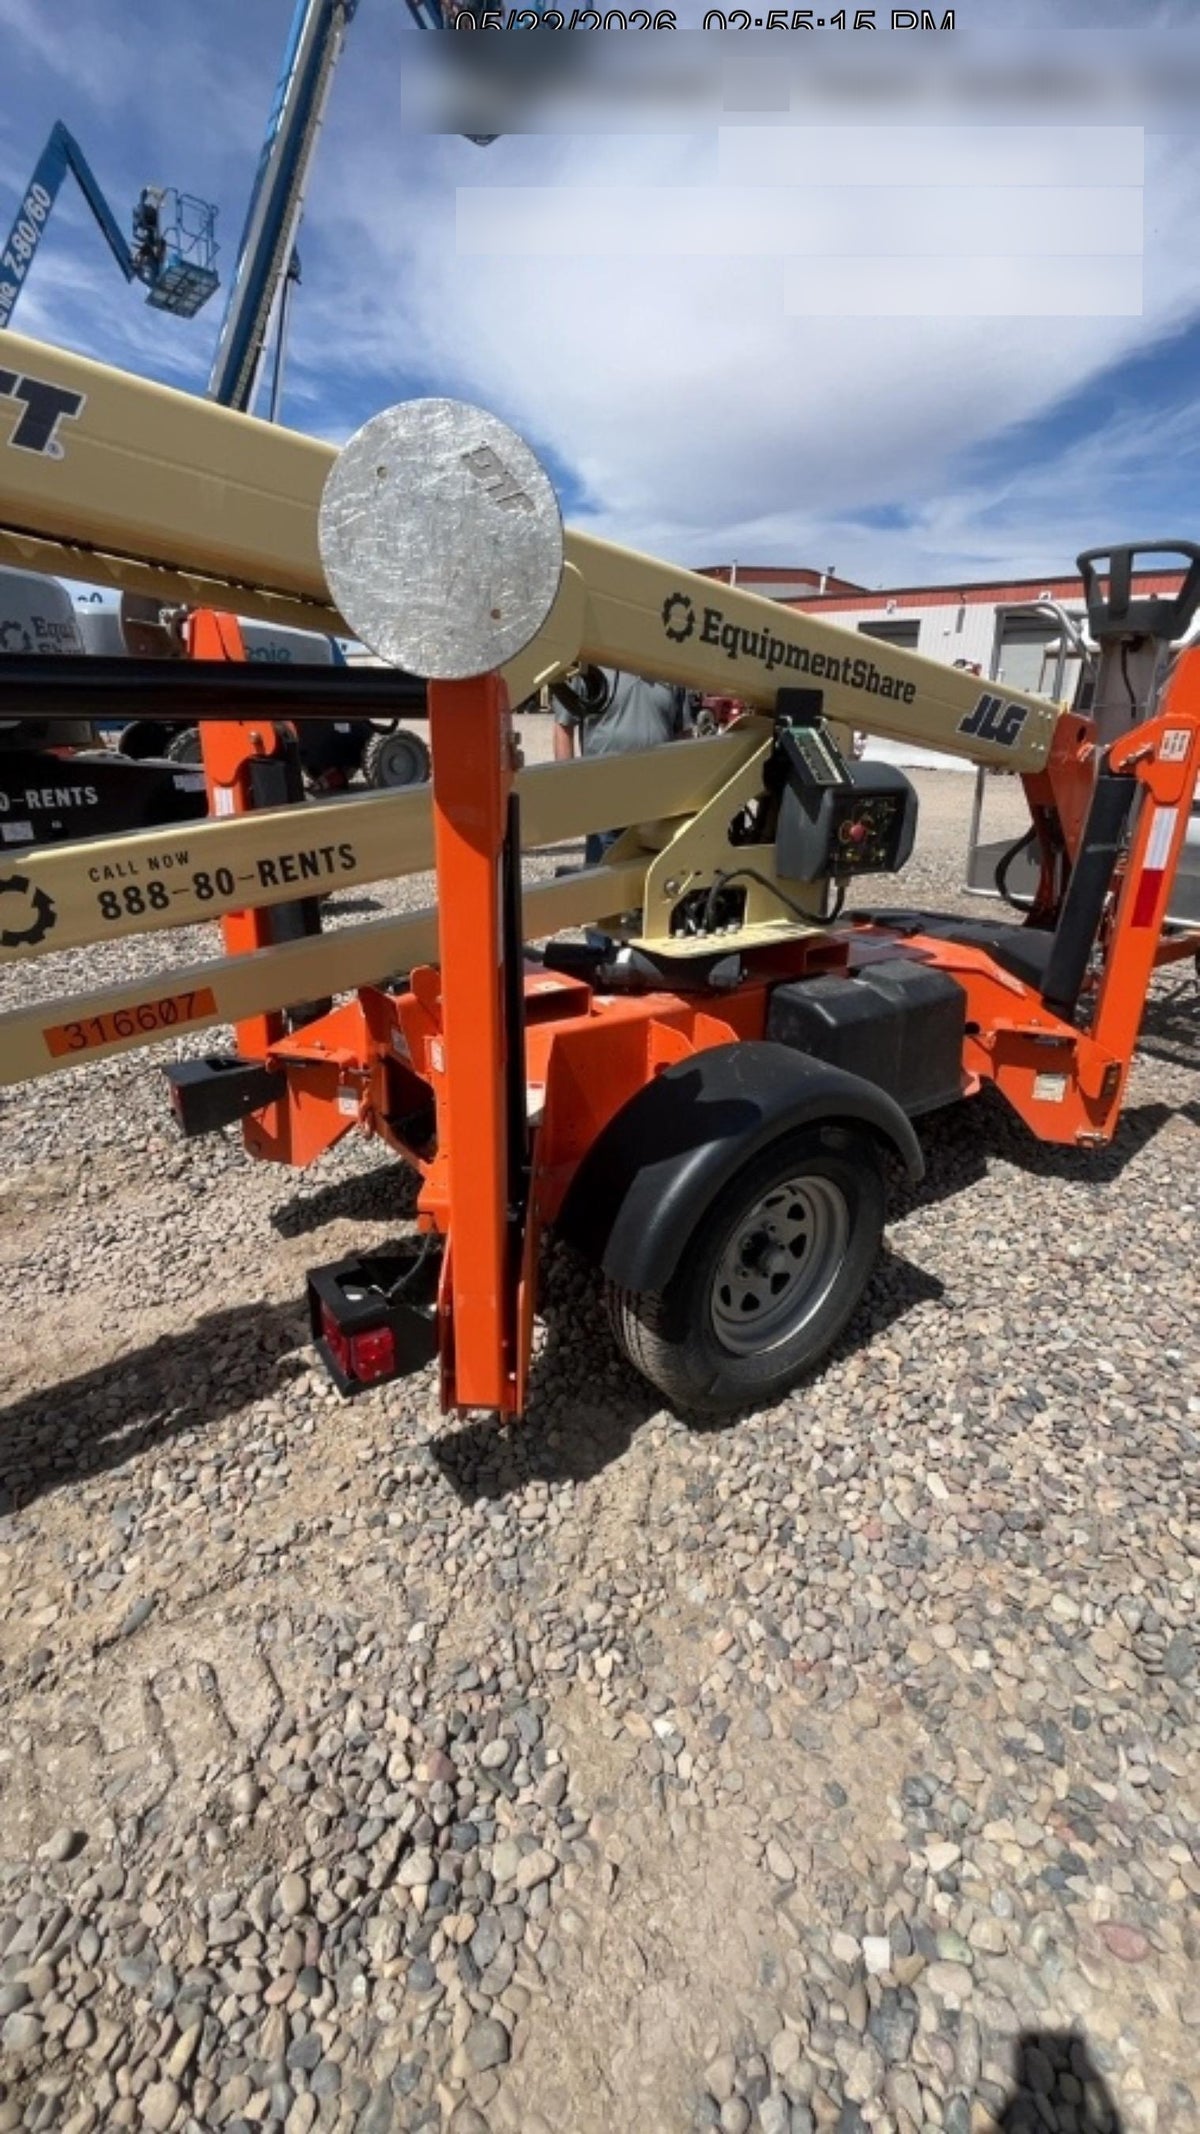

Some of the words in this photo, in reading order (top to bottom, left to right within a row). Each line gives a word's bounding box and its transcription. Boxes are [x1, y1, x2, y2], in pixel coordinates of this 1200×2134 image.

[3, 182, 51, 280] Z-80/60
[699, 607, 916, 704] EquipmentShare
[957, 691, 1028, 748] JLG
[88, 860, 139, 882] CALL
[148, 851, 190, 871] NOW
[97, 843, 357, 920] 888-80-RENTS
[64, 993, 196, 1049] 316607
